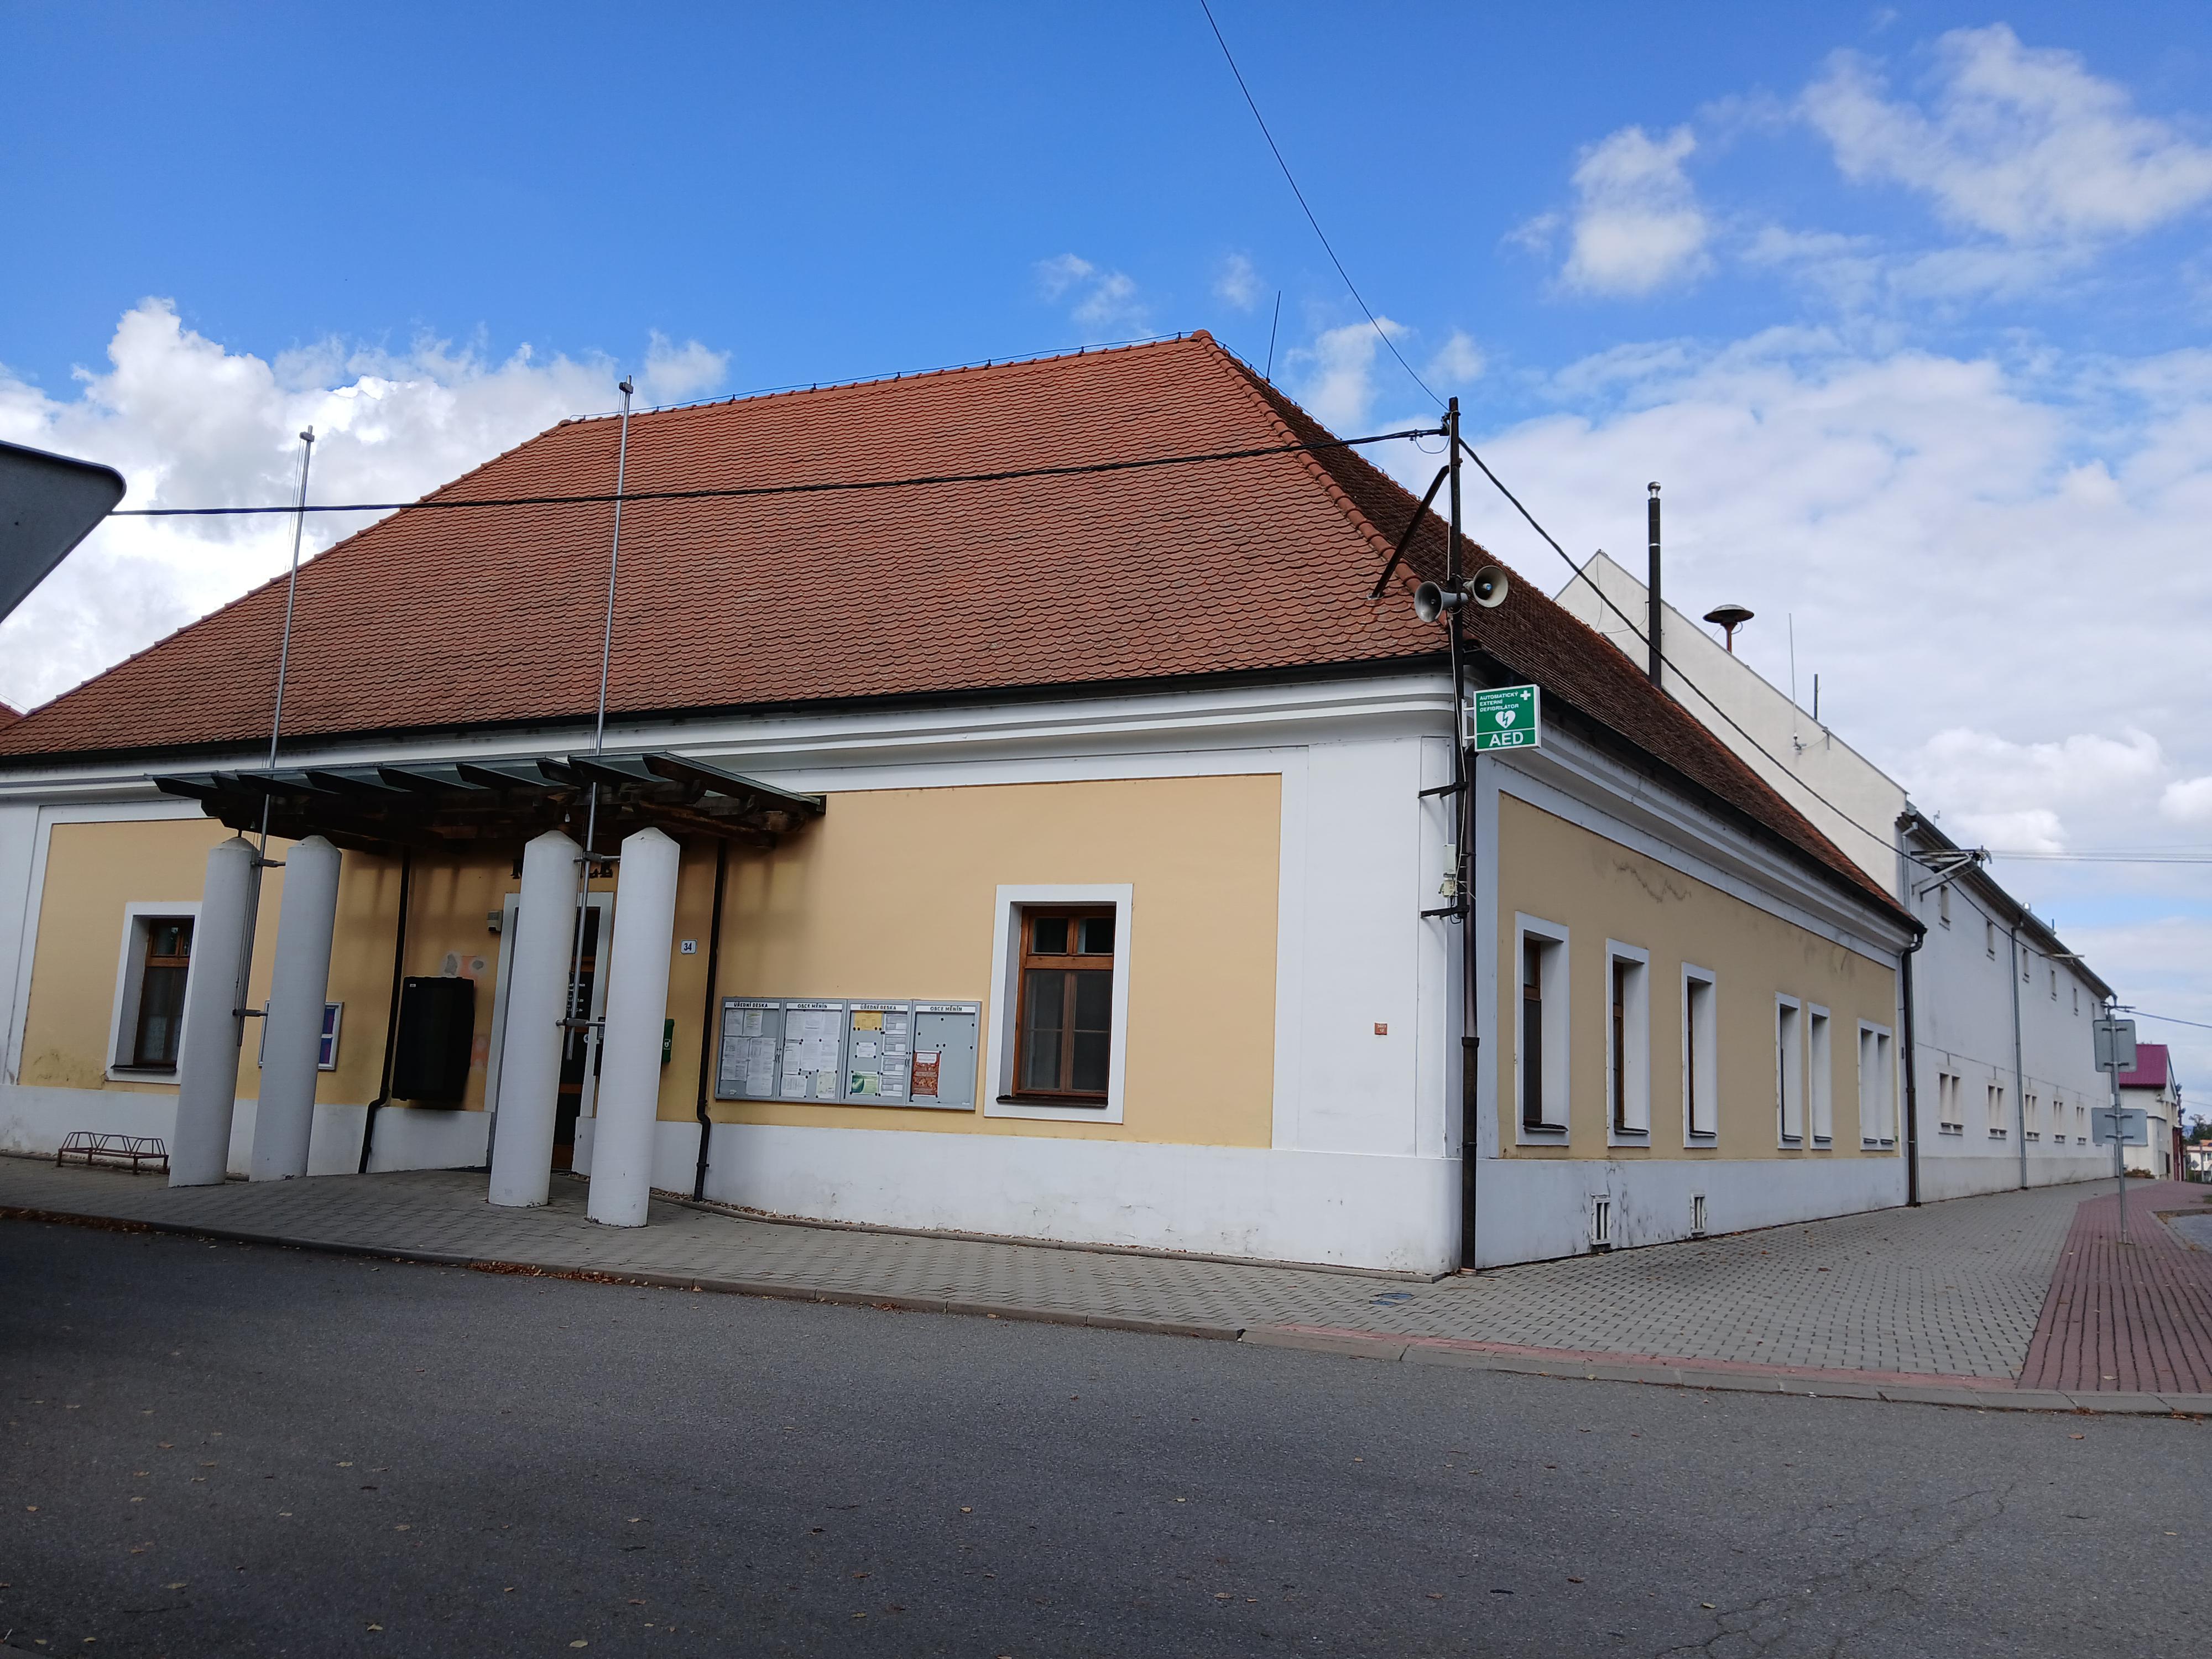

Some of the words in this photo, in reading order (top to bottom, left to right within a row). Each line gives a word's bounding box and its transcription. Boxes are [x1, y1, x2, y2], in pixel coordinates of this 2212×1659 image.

[1480, 691, 1518, 700] AUTOMATICKÝ
[1480, 703, 1519, 712] DEFIBRILÁTOR
[1489, 732, 1524, 747] AED
[684, 942, 692, 951] 34
